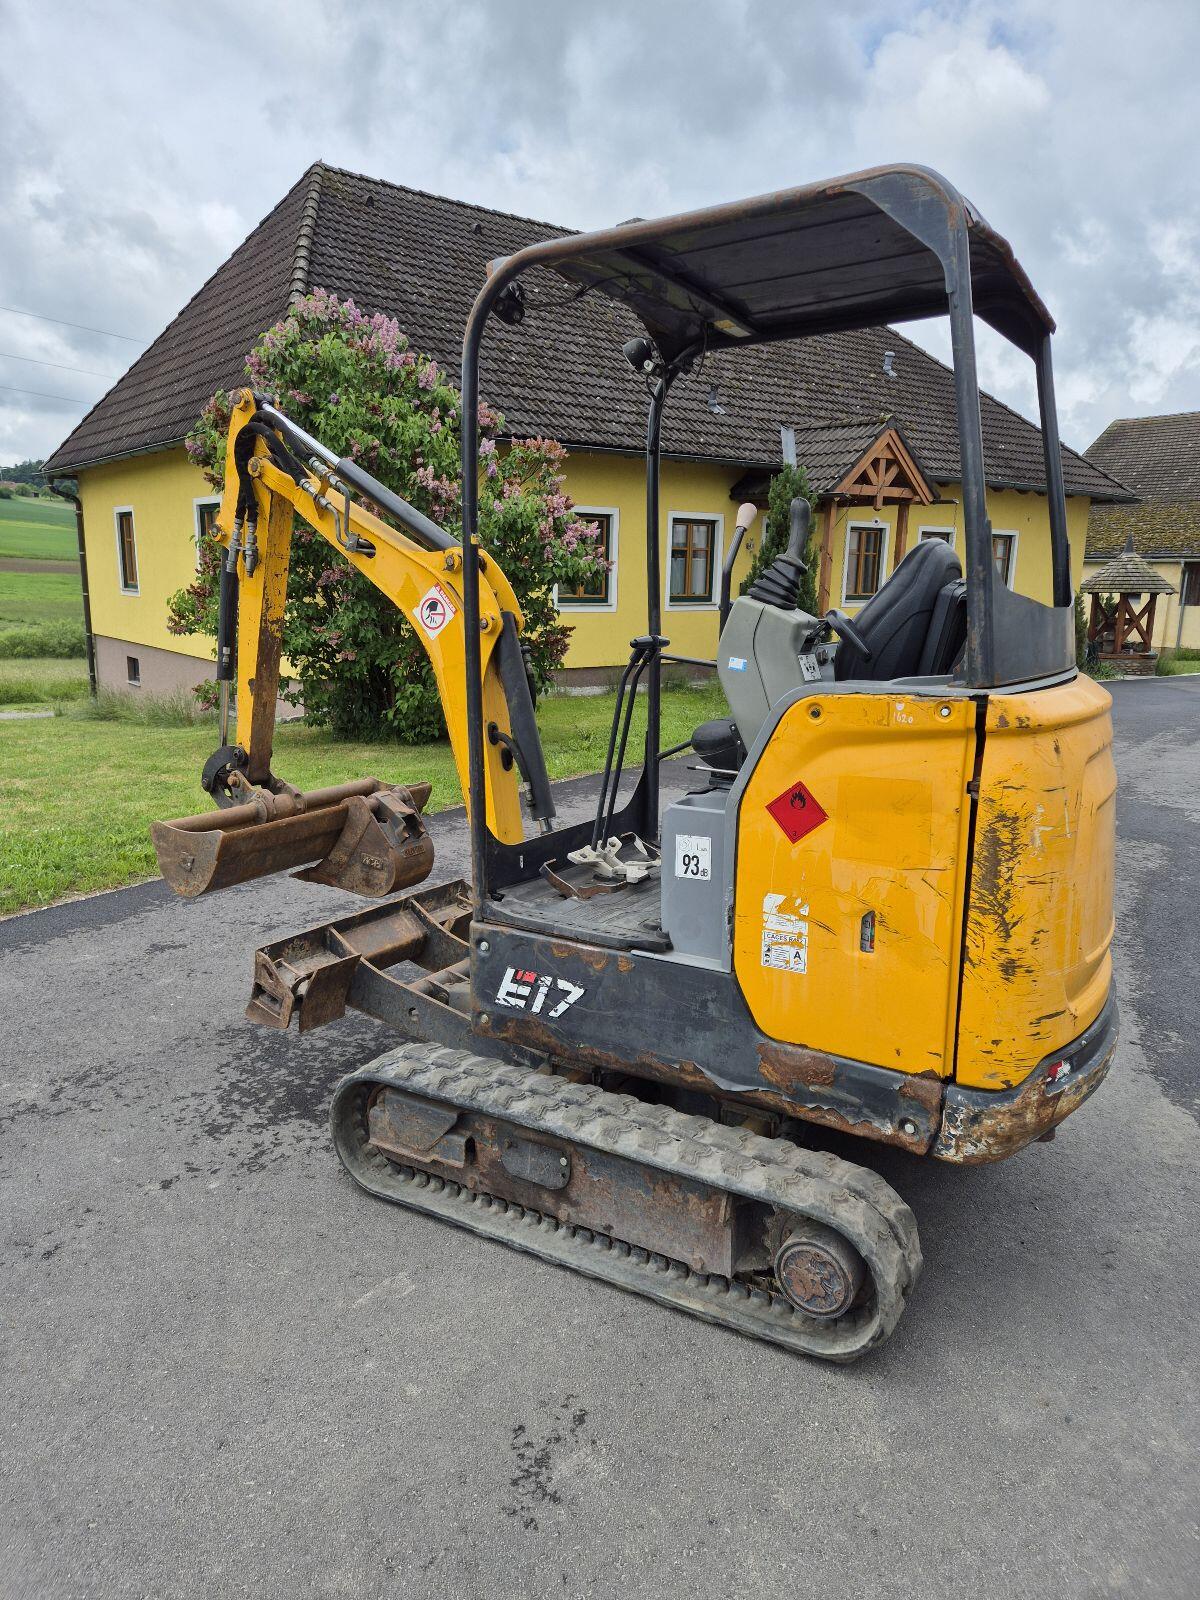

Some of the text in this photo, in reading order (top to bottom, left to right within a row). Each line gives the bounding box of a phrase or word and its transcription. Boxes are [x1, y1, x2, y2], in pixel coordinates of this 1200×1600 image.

[682, 853, 709, 877] 93 dB
[793, 950, 802, 961] A
[495, 966, 585, 1018] E17
